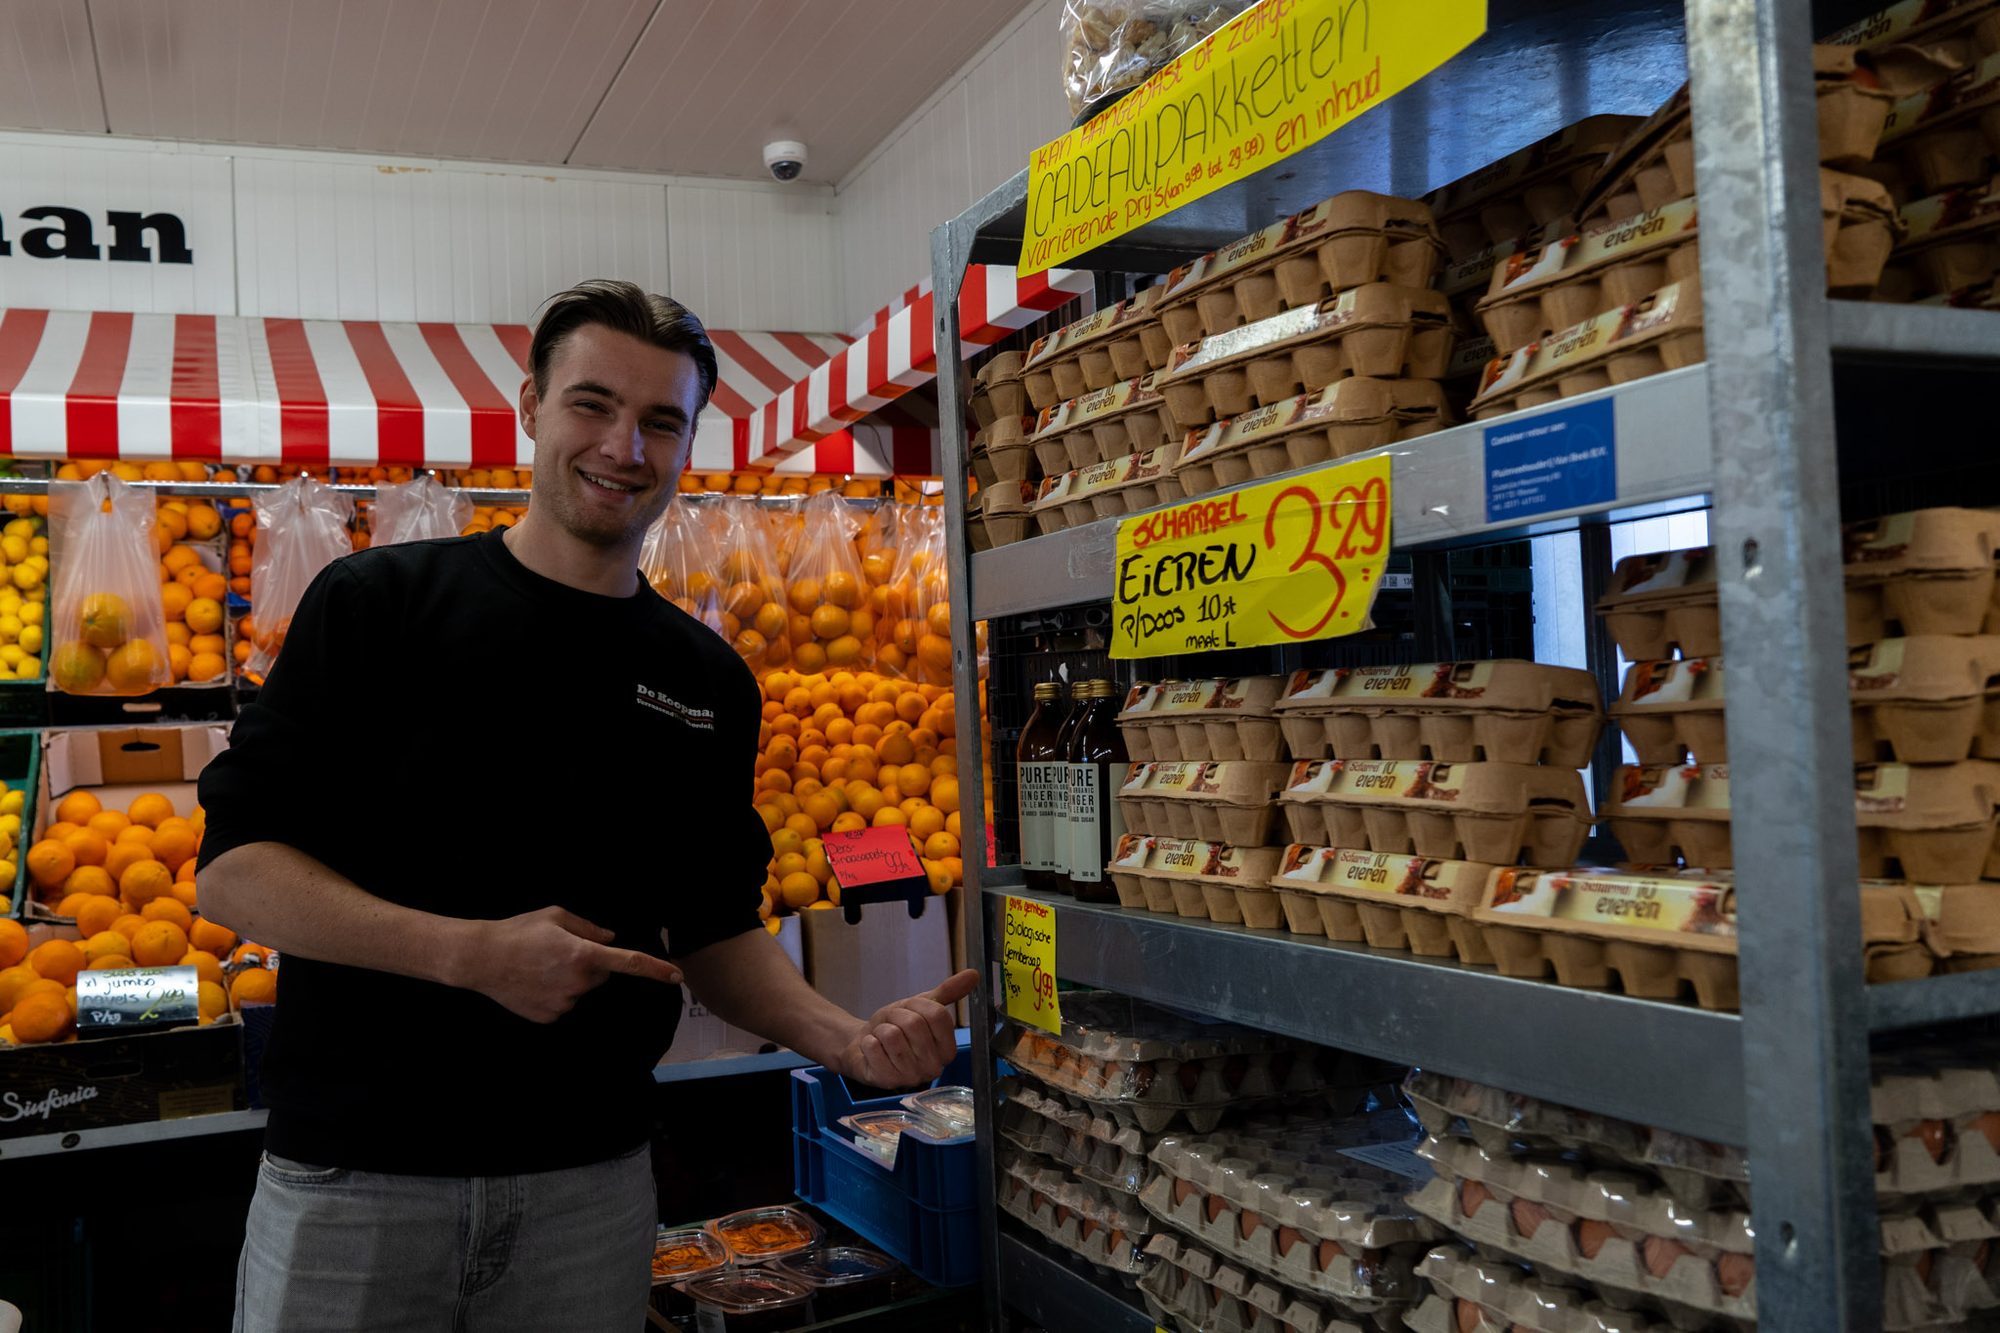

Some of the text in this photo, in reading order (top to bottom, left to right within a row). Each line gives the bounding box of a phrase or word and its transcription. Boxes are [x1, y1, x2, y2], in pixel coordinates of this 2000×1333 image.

[1275, 113, 1307, 153] en
[1316, 55, 1380, 129] inhoud
[0, 206, 193, 264] an
[1133, 492, 1249, 548] SCHARREL
[1364, 677, 1411, 691] eieren
[1355, 774, 1397, 790] eieren
[1165, 852, 1195, 867] eieren
[1347, 865, 1388, 884] eieren
